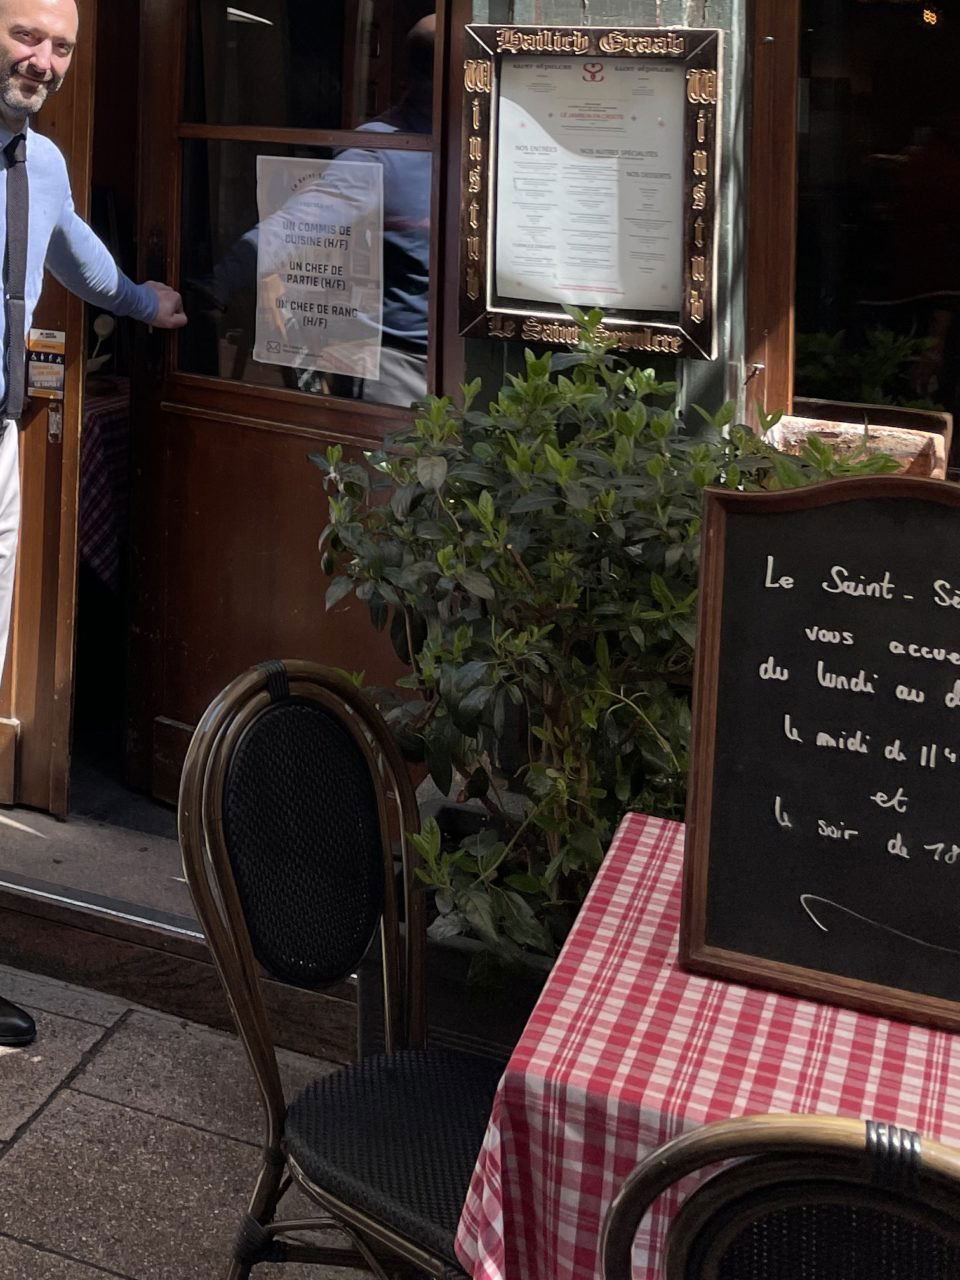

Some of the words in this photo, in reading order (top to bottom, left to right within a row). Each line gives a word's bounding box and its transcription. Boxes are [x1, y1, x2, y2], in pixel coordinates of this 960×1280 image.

[496, 28, 589, 54] Hailich
[599, 31, 685, 54] Graab
[282, 221, 296, 231] UN
[298, 222, 336, 235] COMMIS
[339, 225, 351, 236] DE
[285, 234, 322, 247] CUISINE
[323, 238, 349, 251] (H/F)
[289, 261, 302, 271] UN
[305, 263, 328, 274] CHEF
[331, 265, 343, 276] DE
[287, 274, 319, 287] PARTIE
[321, 278, 346, 290] (H/F)
[290, 301, 314, 312] CHEF
[317, 304, 328, 314] DE
[303, 315, 328, 329] (H/F)
[764, 555, 795, 589] Le
[821, 565, 895, 599] Saint
[805, 626, 854, 645] vous
[759, 656, 789, 681] du
[817, 660, 879, 694] lundi
[895, 684, 925, 703] au
[816, 730, 871, 754] midi
[870, 787, 909, 813] et
[818, 819, 858, 840] soir
